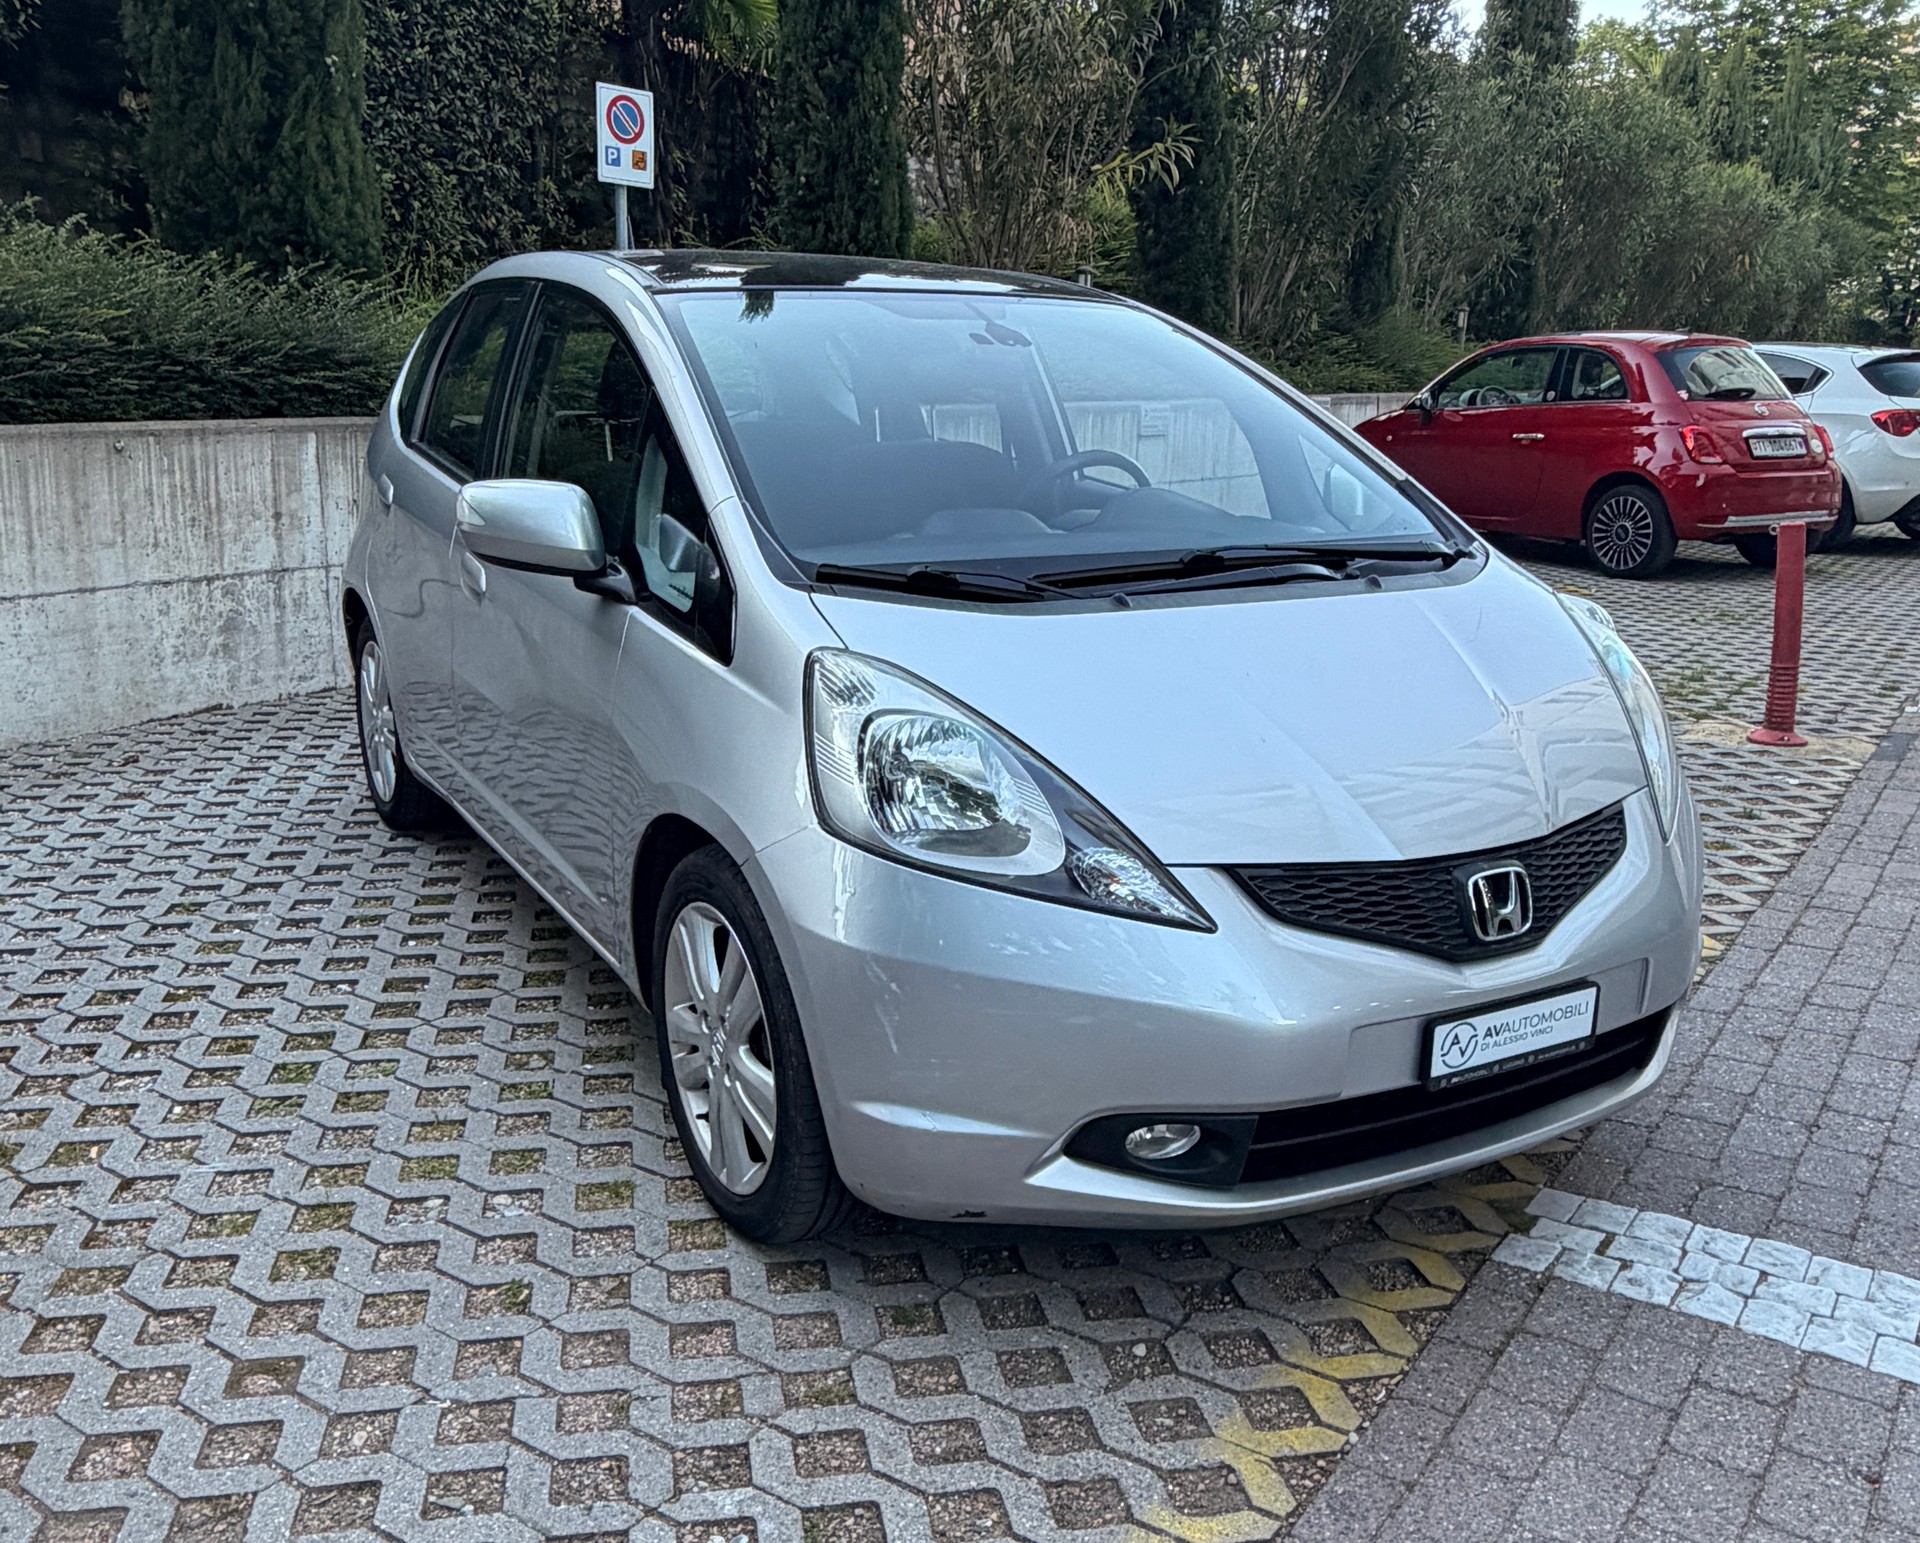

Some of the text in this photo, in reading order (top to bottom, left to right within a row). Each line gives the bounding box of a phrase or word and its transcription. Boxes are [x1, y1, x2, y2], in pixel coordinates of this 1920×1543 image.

[607, 148, 618, 165] P
[1482, 1001, 1589, 1041] AVAUTOMOBILI
[1480, 1025, 1553, 1052] DI ALESSIO VINCI
